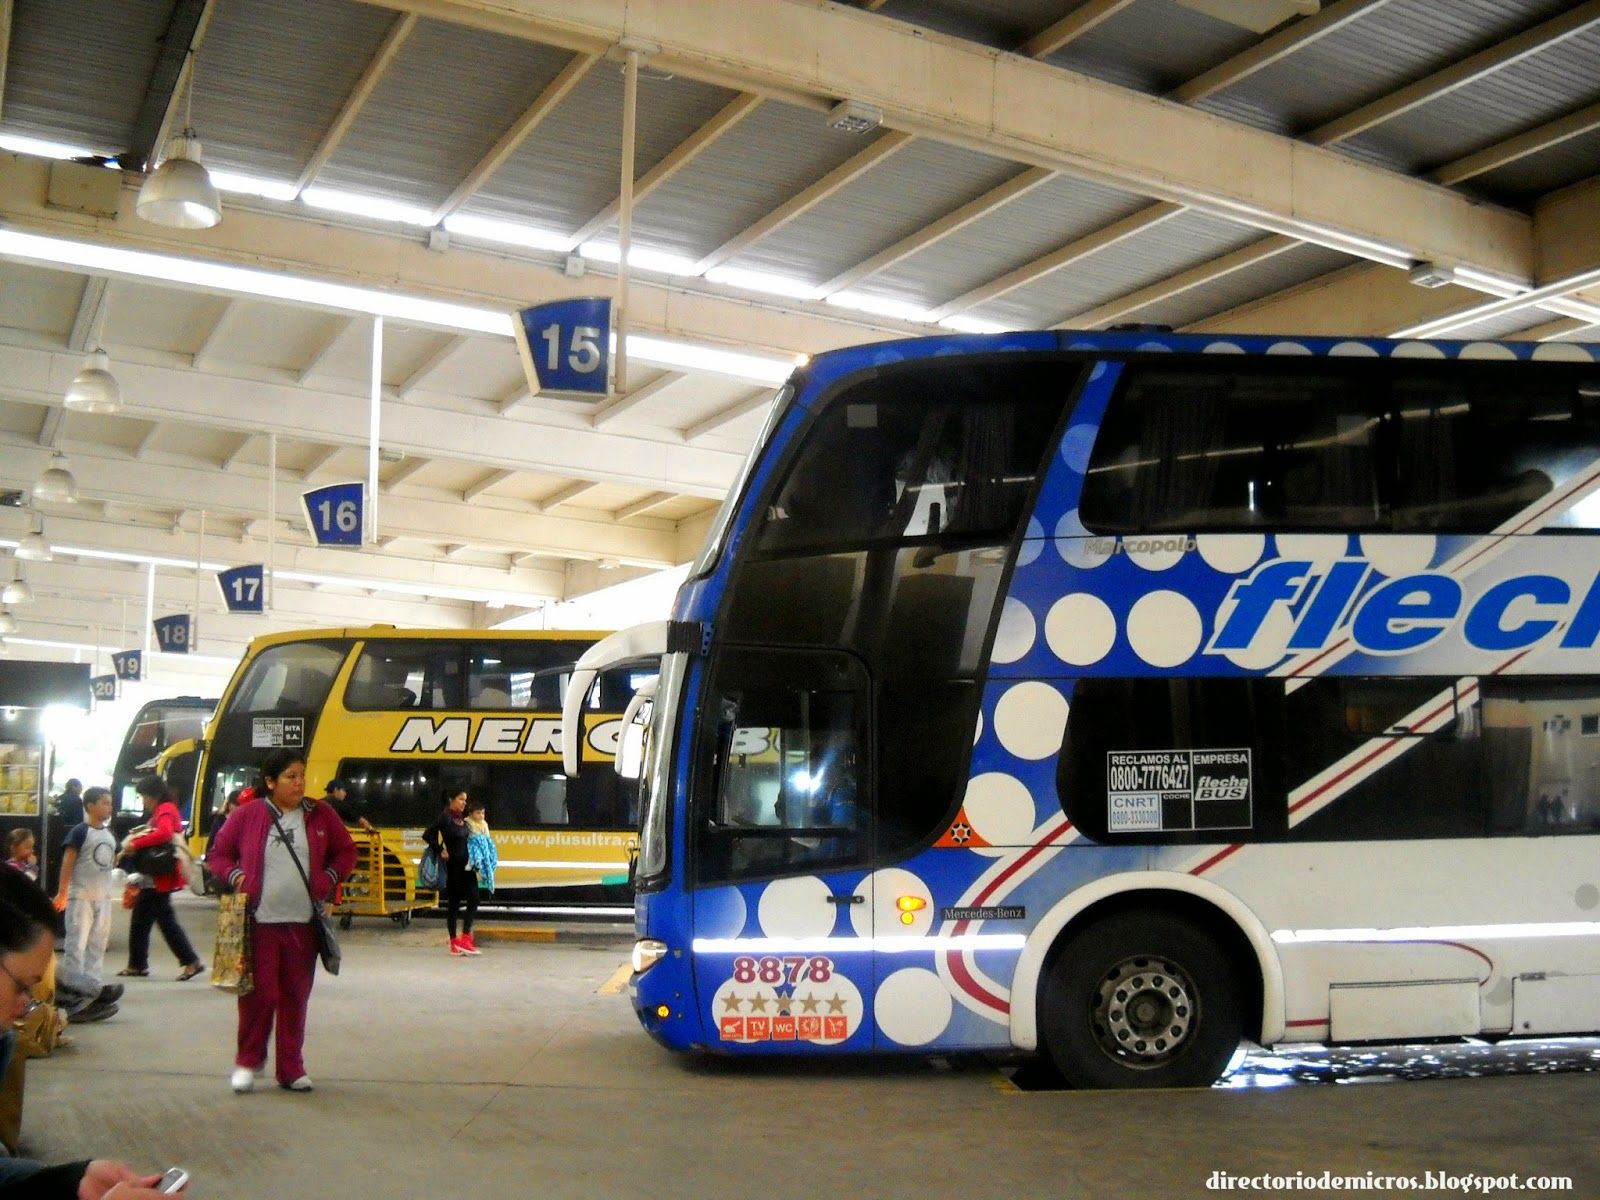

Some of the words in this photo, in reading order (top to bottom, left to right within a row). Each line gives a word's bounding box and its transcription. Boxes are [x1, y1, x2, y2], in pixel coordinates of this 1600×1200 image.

[542, 323, 601, 374] 15
[318, 500, 358, 532] 16
[1083, 537, 1198, 556] Marcopolo
[231, 577, 261, 602] 17
[161, 624, 186, 645] 18
[117, 657, 138, 675] 19
[95, 682, 114, 697] 20
[1112, 754, 1171, 765] RECLAMOS
[1173, 753, 1187, 764] AL
[1193, 753, 1248, 765] EMPRESA
[1110, 764, 1189, 791] 0800-7776427
[1198, 775, 1249, 788] flecha
[1199, 787, 1244, 799] BUS
[1114, 797, 1157, 808] CNRT
[944, 907, 1023, 919] Mercedes-Benz
[733, 956, 834, 986] 8878
[751, 1021, 766, 1031] TV
[775, 1023, 793, 1033] WC
